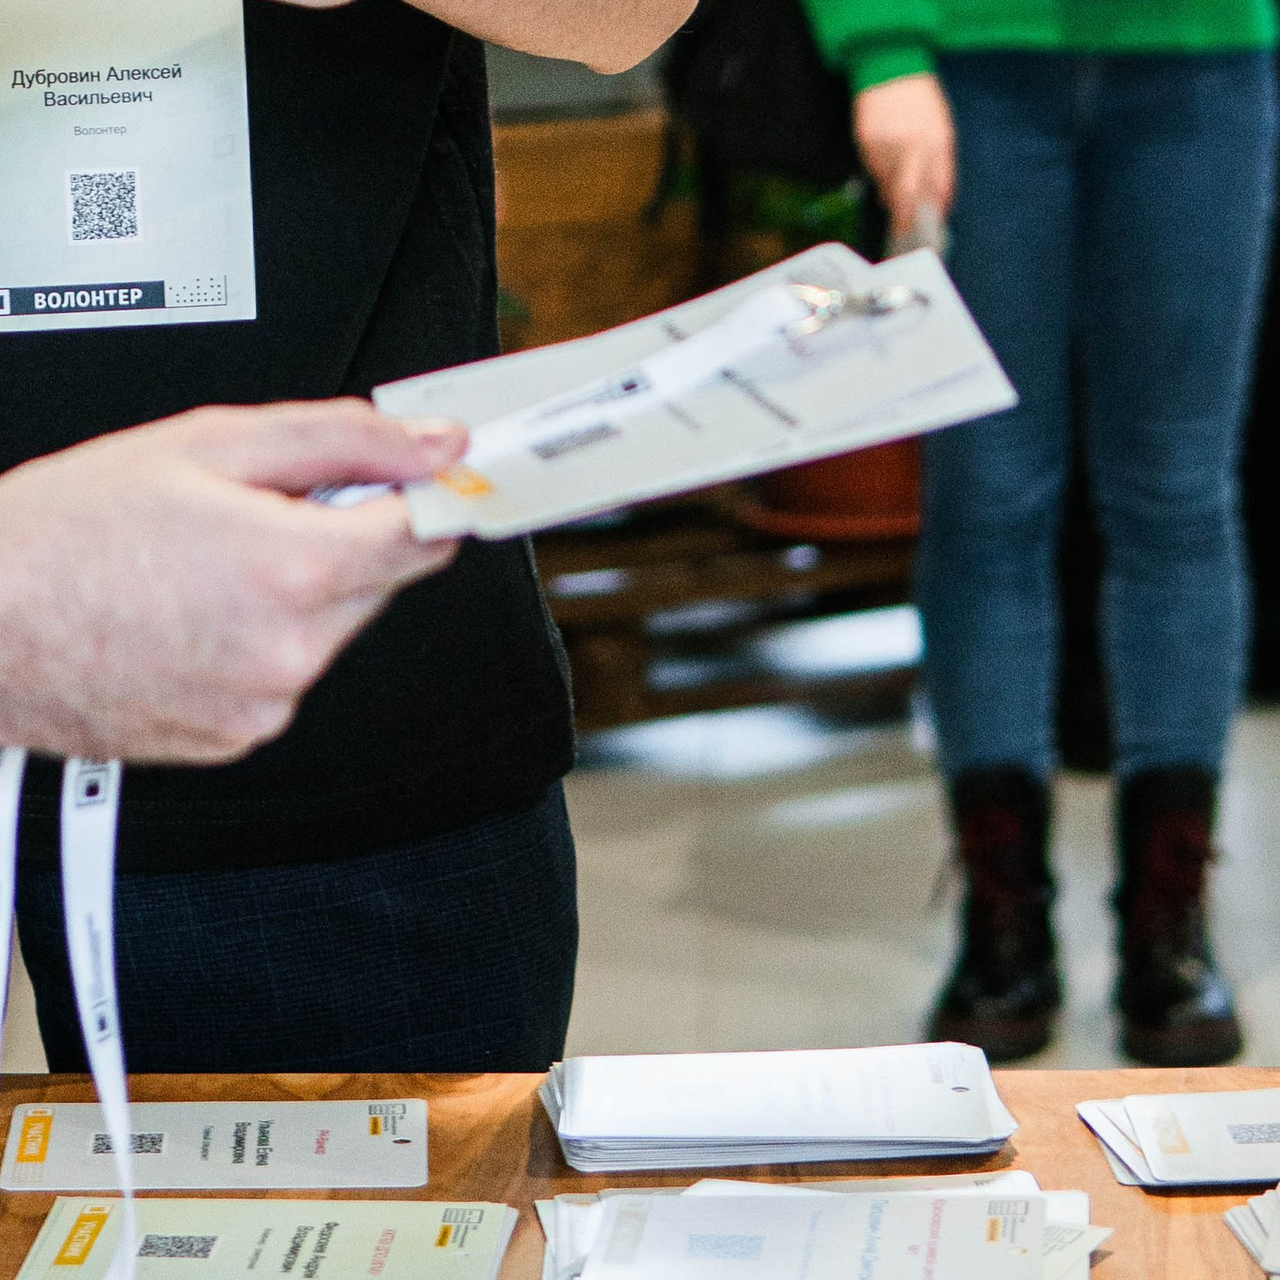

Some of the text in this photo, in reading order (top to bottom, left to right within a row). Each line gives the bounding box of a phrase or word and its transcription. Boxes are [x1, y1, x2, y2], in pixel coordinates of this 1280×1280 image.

[11, 64, 182, 89] Дубровин Алексей
[44, 90, 153, 107] Васильевич
[73, 125, 127, 137] Волонтер
[34, 287, 144, 311] ВОЛОНТЕР
